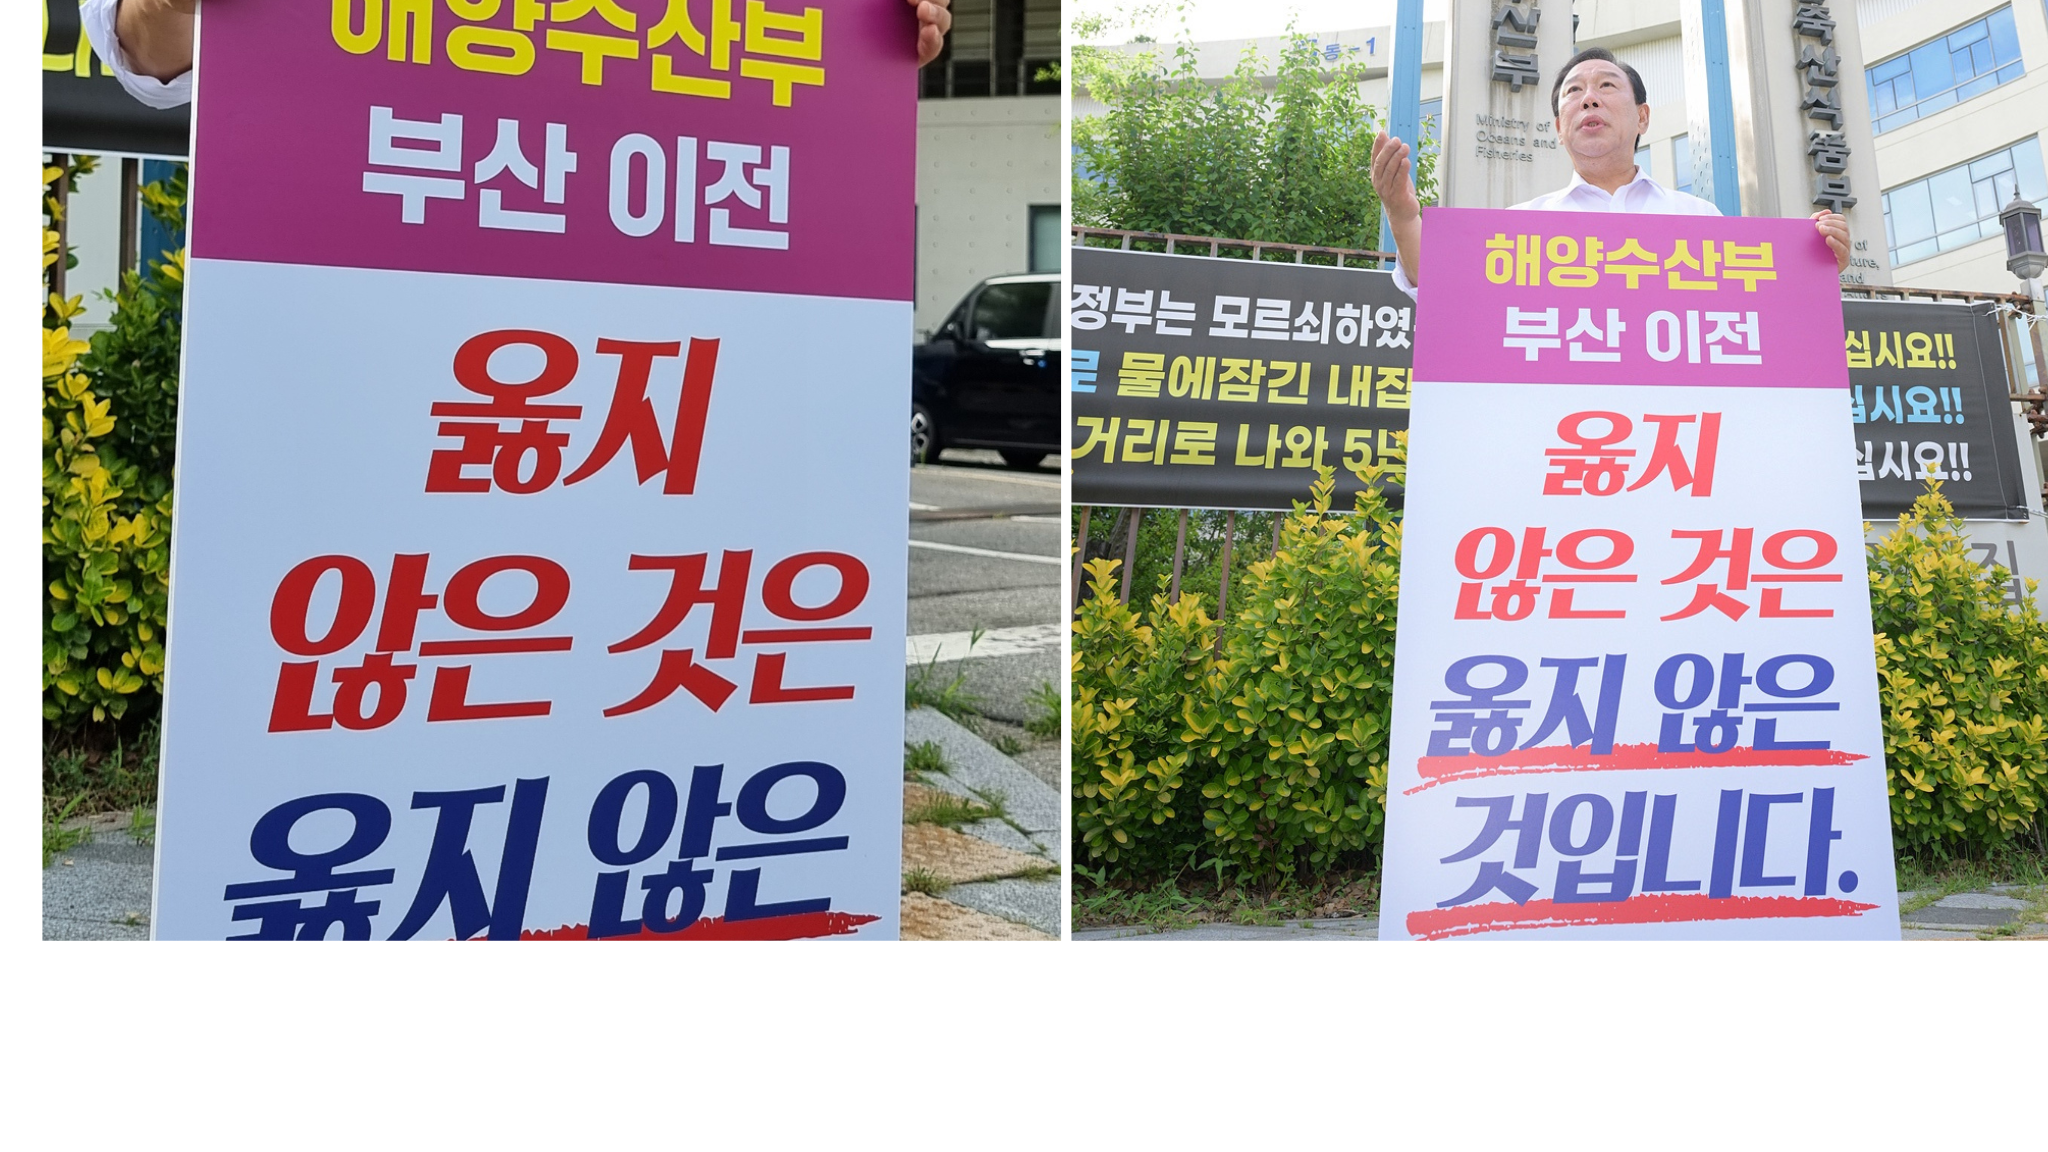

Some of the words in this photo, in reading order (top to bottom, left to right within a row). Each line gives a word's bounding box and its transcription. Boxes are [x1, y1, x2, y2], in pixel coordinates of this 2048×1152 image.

[330, 0, 825, 107] 해양수산부
[1492, 0, 1542, 93] 산부
[1476, 114, 1530, 132] Ministry
[1536, 121, 1551, 133] of
[1476, 130, 1526, 147] Oceans
[1533, 137, 1557, 150] and
[1793, 0, 1857, 213] 축산식품부
[362, 105, 577, 234] 부산
[608, 132, 790, 250] 이전
[1475, 145, 1534, 162] Fisheries
[1485, 233, 1778, 293] 해양수산부
[1071, 284, 1197, 336] 정부는
[1208, 294, 1416, 350] 모르쇠하였
[1502, 305, 1627, 363] 부산
[1645, 309, 1763, 366] 이전
[425, 329, 721, 495] 옳지
[1116, 351, 1312, 405] 물에잠긴
[1071, 415, 1218, 466] 거리로
[1235, 422, 1329, 471] 나와
[1542, 410, 1723, 498] 옳지
[1453, 526, 1638, 622] 않은
[1659, 526, 1844, 622] 것은
[267, 552, 573, 733] 않은
[603, 549, 873, 718] 것은
[1426, 652, 1628, 757] 옳지
[1653, 652, 1841, 754] 않은
[223, 775, 550, 941] 옳지
[587, 760, 850, 939] 않은
[1436, 786, 1860, 909] 것입니다.
